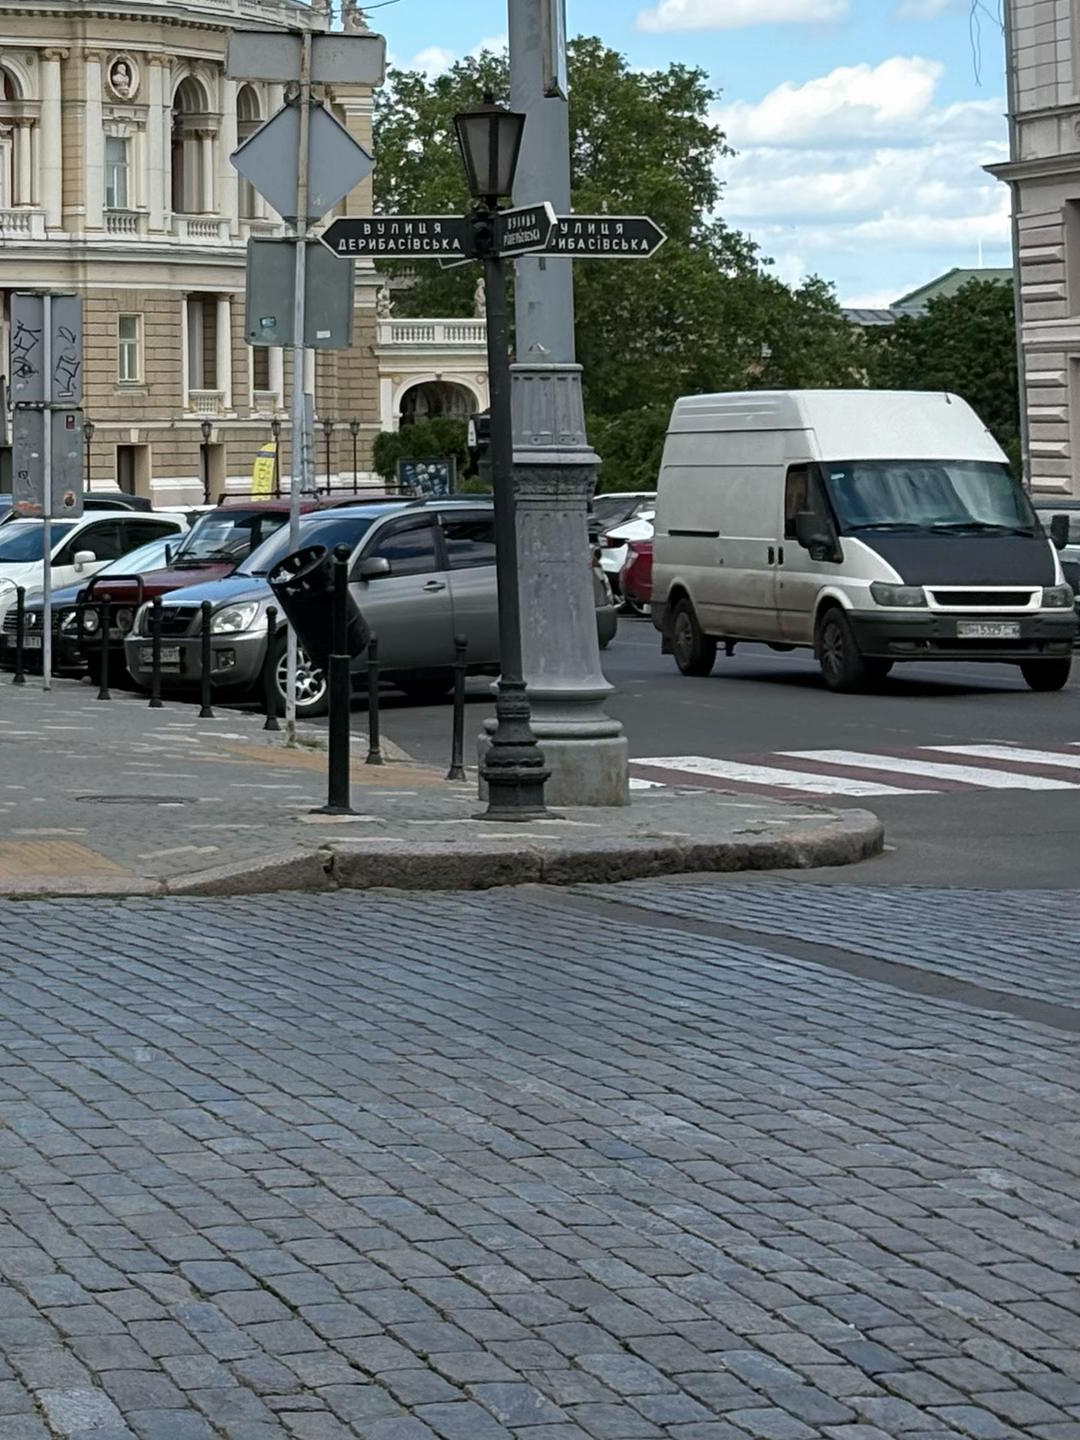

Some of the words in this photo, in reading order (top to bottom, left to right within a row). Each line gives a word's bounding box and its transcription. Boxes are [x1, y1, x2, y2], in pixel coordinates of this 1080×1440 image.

[363, 222, 441, 235] ВУЛИЦЯ
[560, 223, 623, 235] УЛИЦЯ
[338, 235, 461, 250] ДЕРИБАСІВСЬКА
